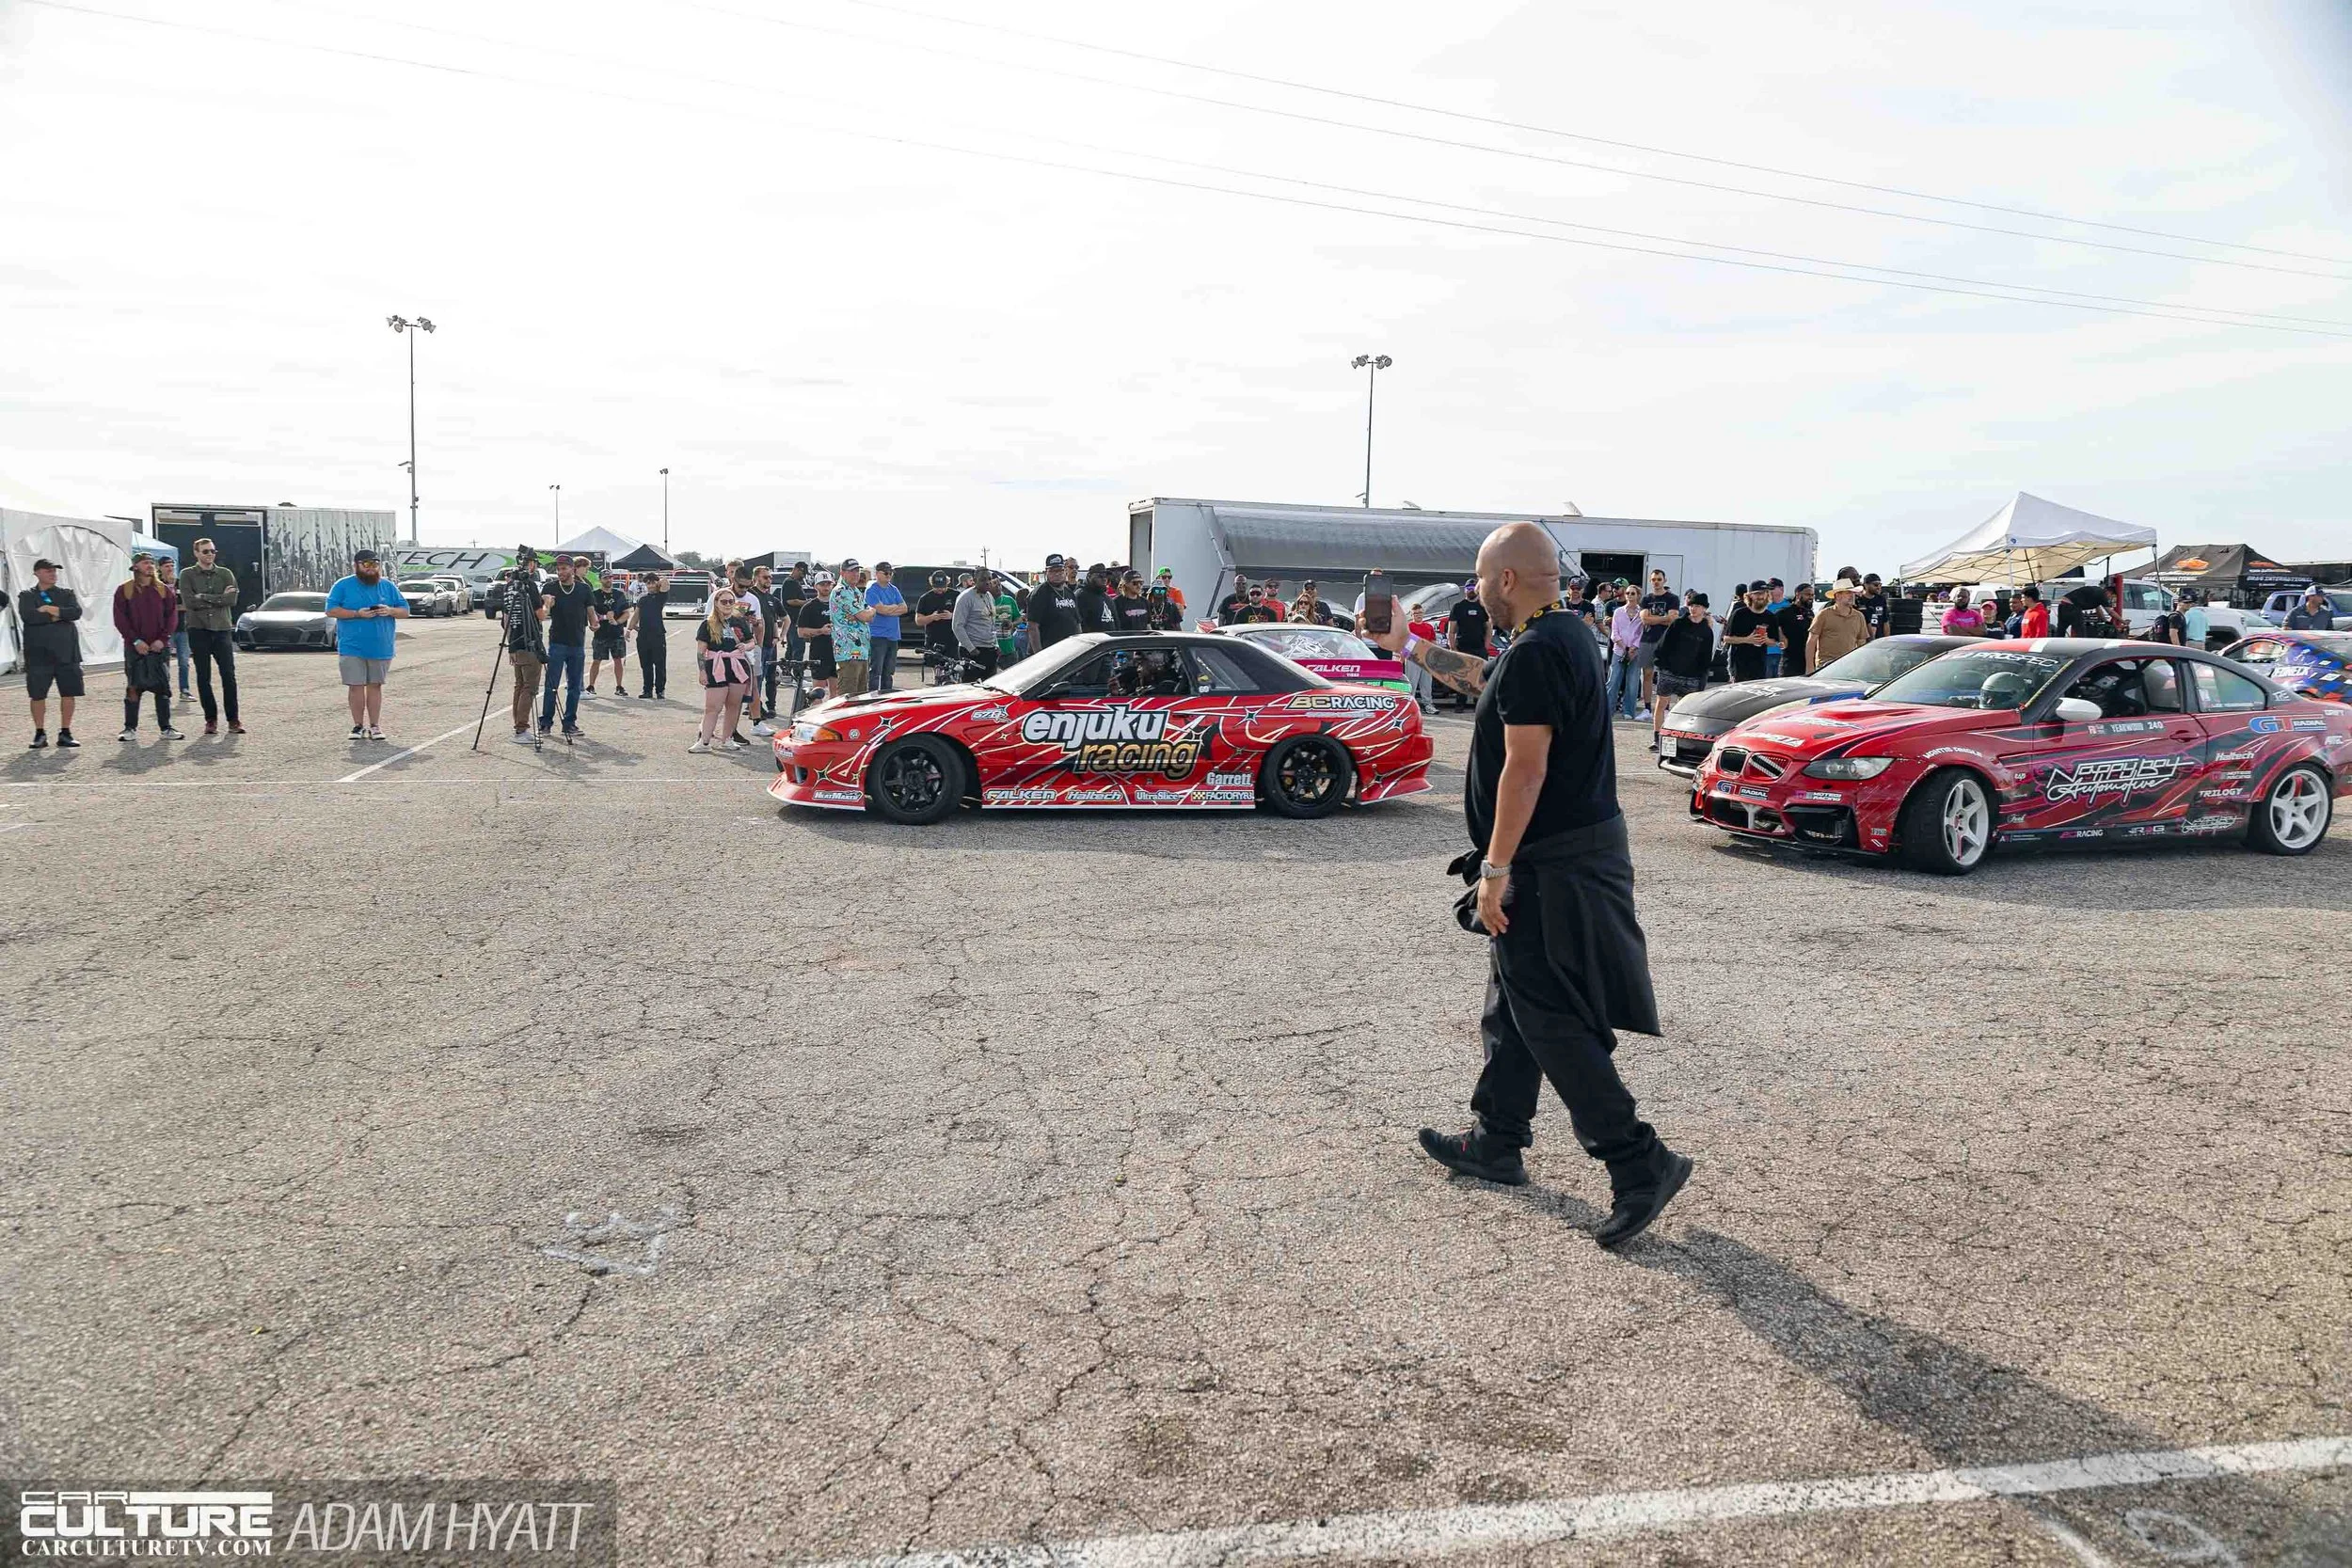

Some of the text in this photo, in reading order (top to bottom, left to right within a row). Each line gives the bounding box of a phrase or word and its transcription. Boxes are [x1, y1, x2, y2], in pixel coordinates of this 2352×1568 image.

[1972, 652, 2058, 667] PROSPEC
[1025, 705, 1167, 749] enjuku
[1080, 743, 1198, 776] racing
[1206, 771, 1252, 785] Garrett
[986, 790, 1056, 800] FALKEN
[1068, 791, 1122, 800] Haltech
[2199, 787, 2243, 798] TRILOGY
